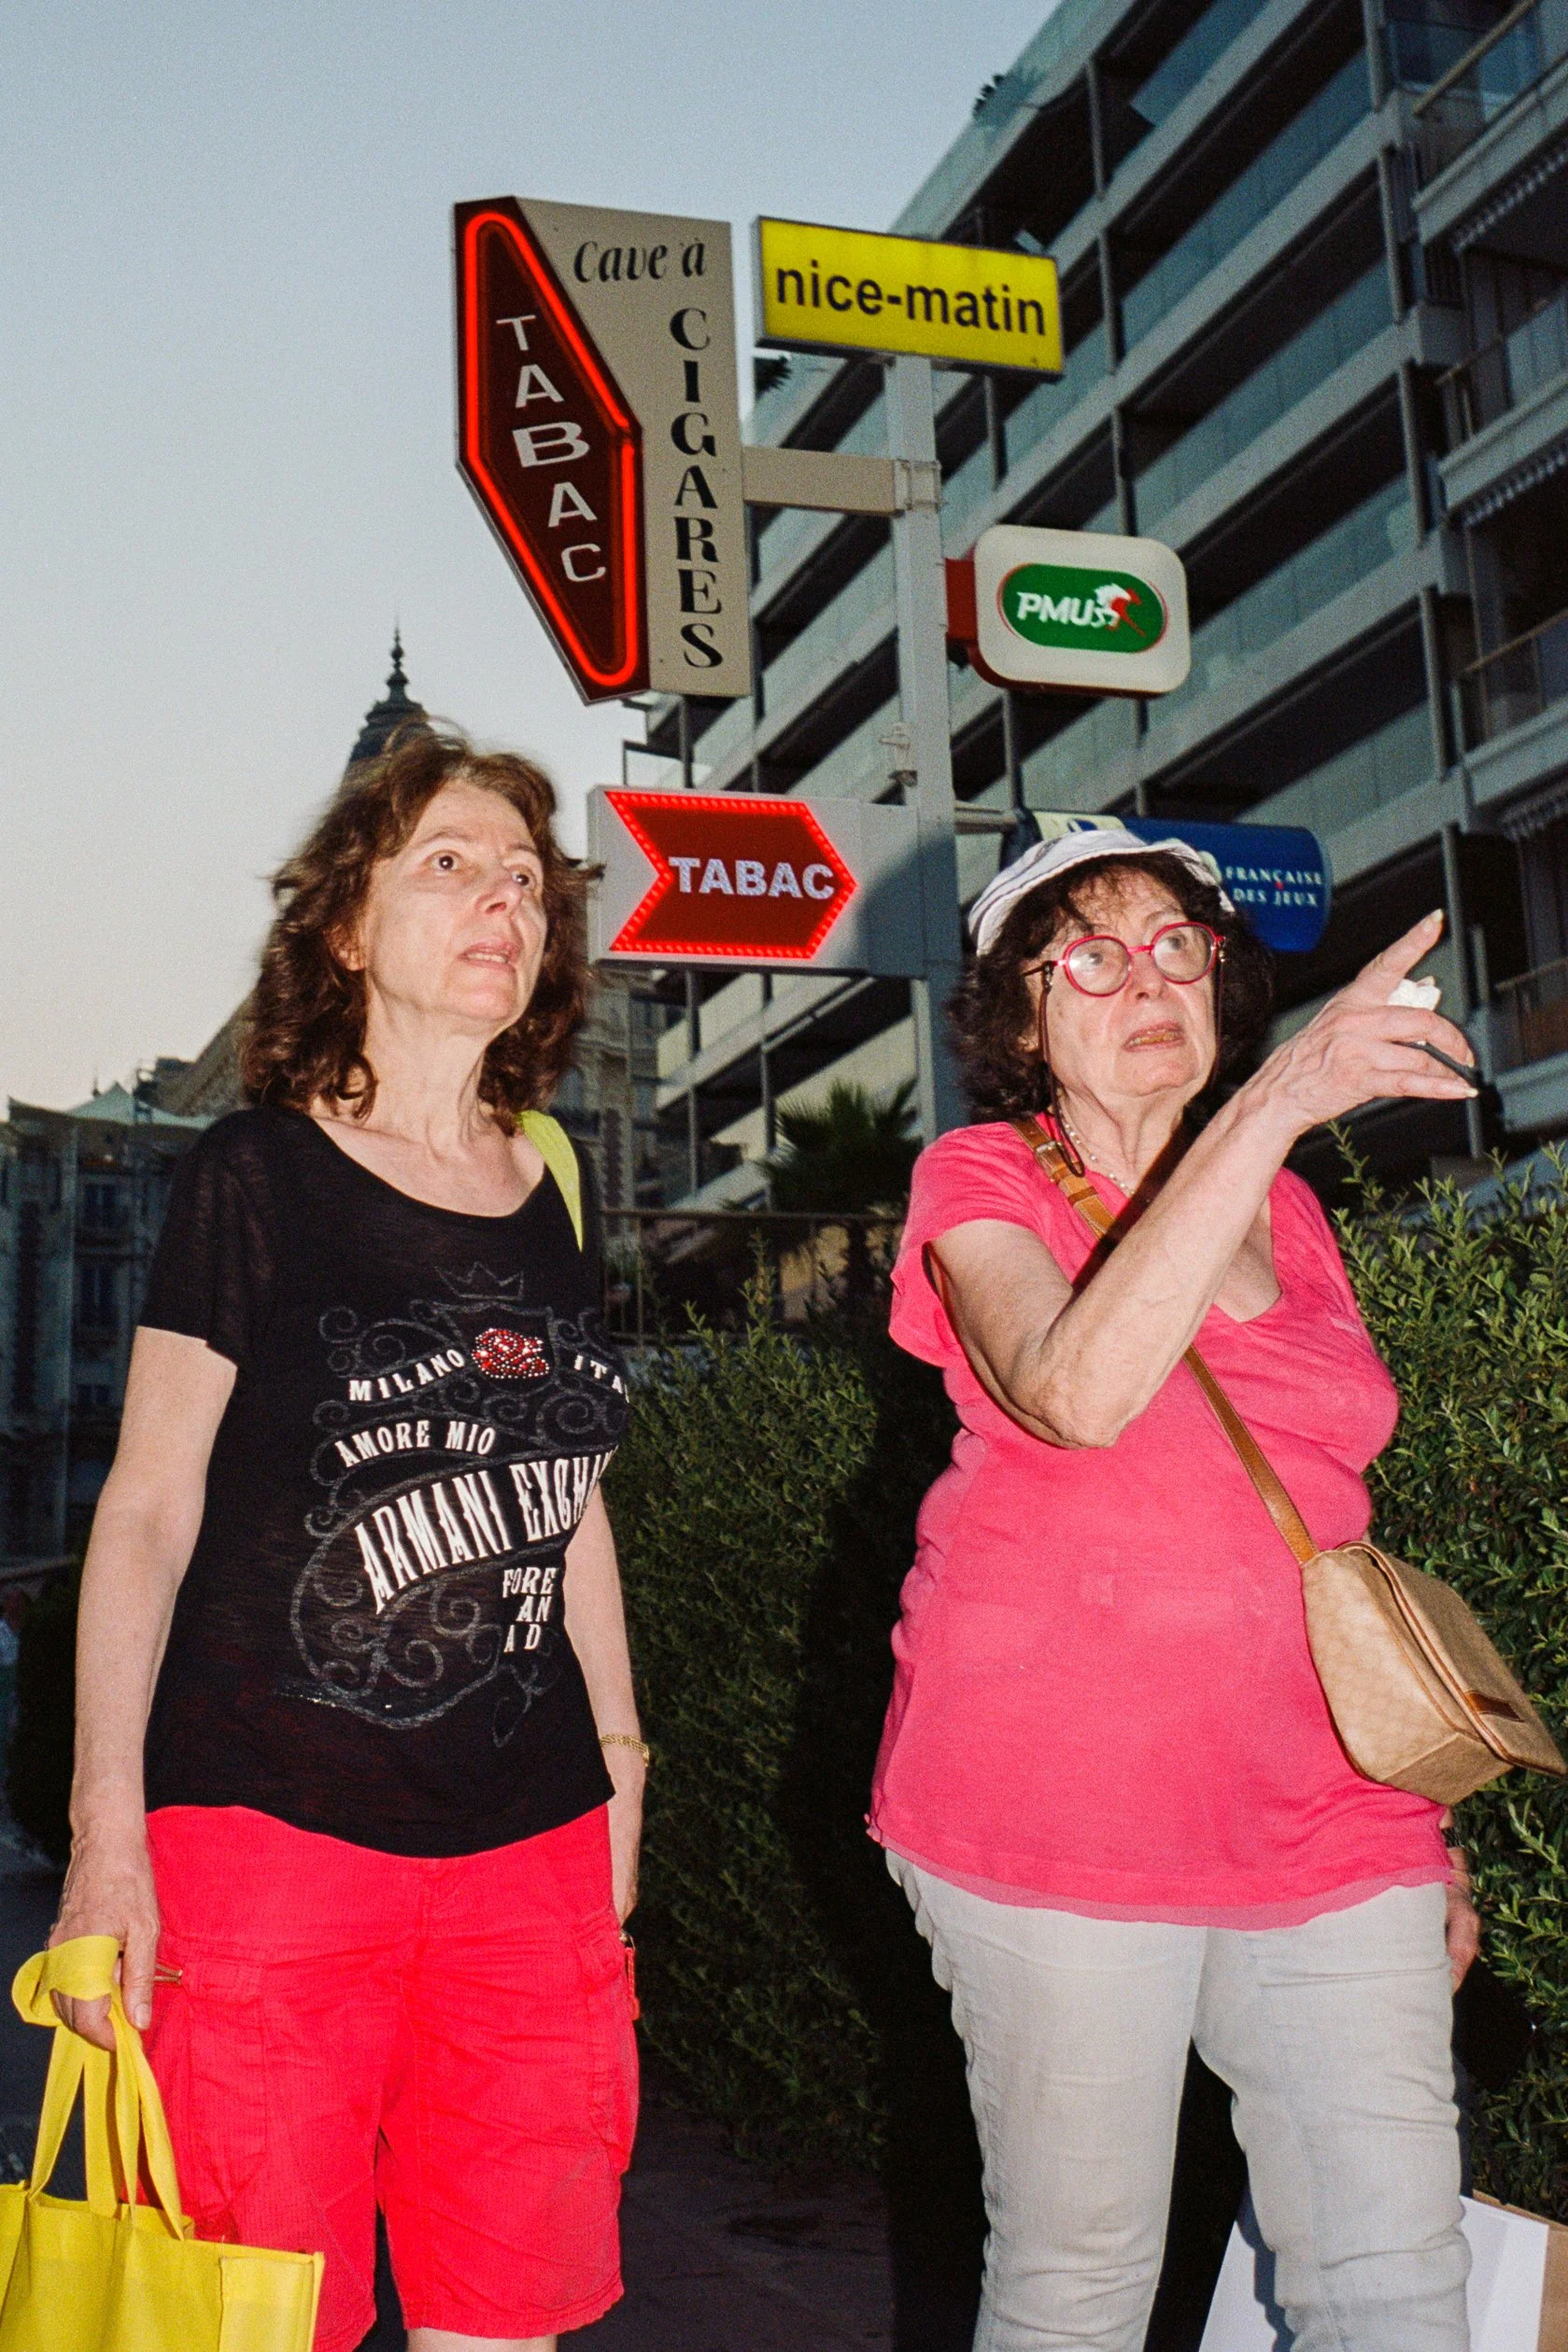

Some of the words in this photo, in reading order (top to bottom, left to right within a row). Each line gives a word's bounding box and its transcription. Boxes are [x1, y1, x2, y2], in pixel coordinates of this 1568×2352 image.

[573, 240, 667, 282] Cave
[682, 236, 706, 278] à
[775, 260, 1047, 336] nice-matin
[496, 315, 607, 583] TABAC
[669, 307, 724, 669] CIGARES
[1016, 591, 1095, 627] PMU
[669, 857, 835, 900] TABAC
[1233, 887, 1267, 904] DES
[1273, 890, 1319, 907] JEUX
[348, 1349, 466, 1401] MILANO
[573, 1353, 630, 1404] ITA
[334, 1419, 431, 1468] AMORE
[445, 1420, 497, 1455] MIO
[354, 1470, 514, 1615] ARMANI
